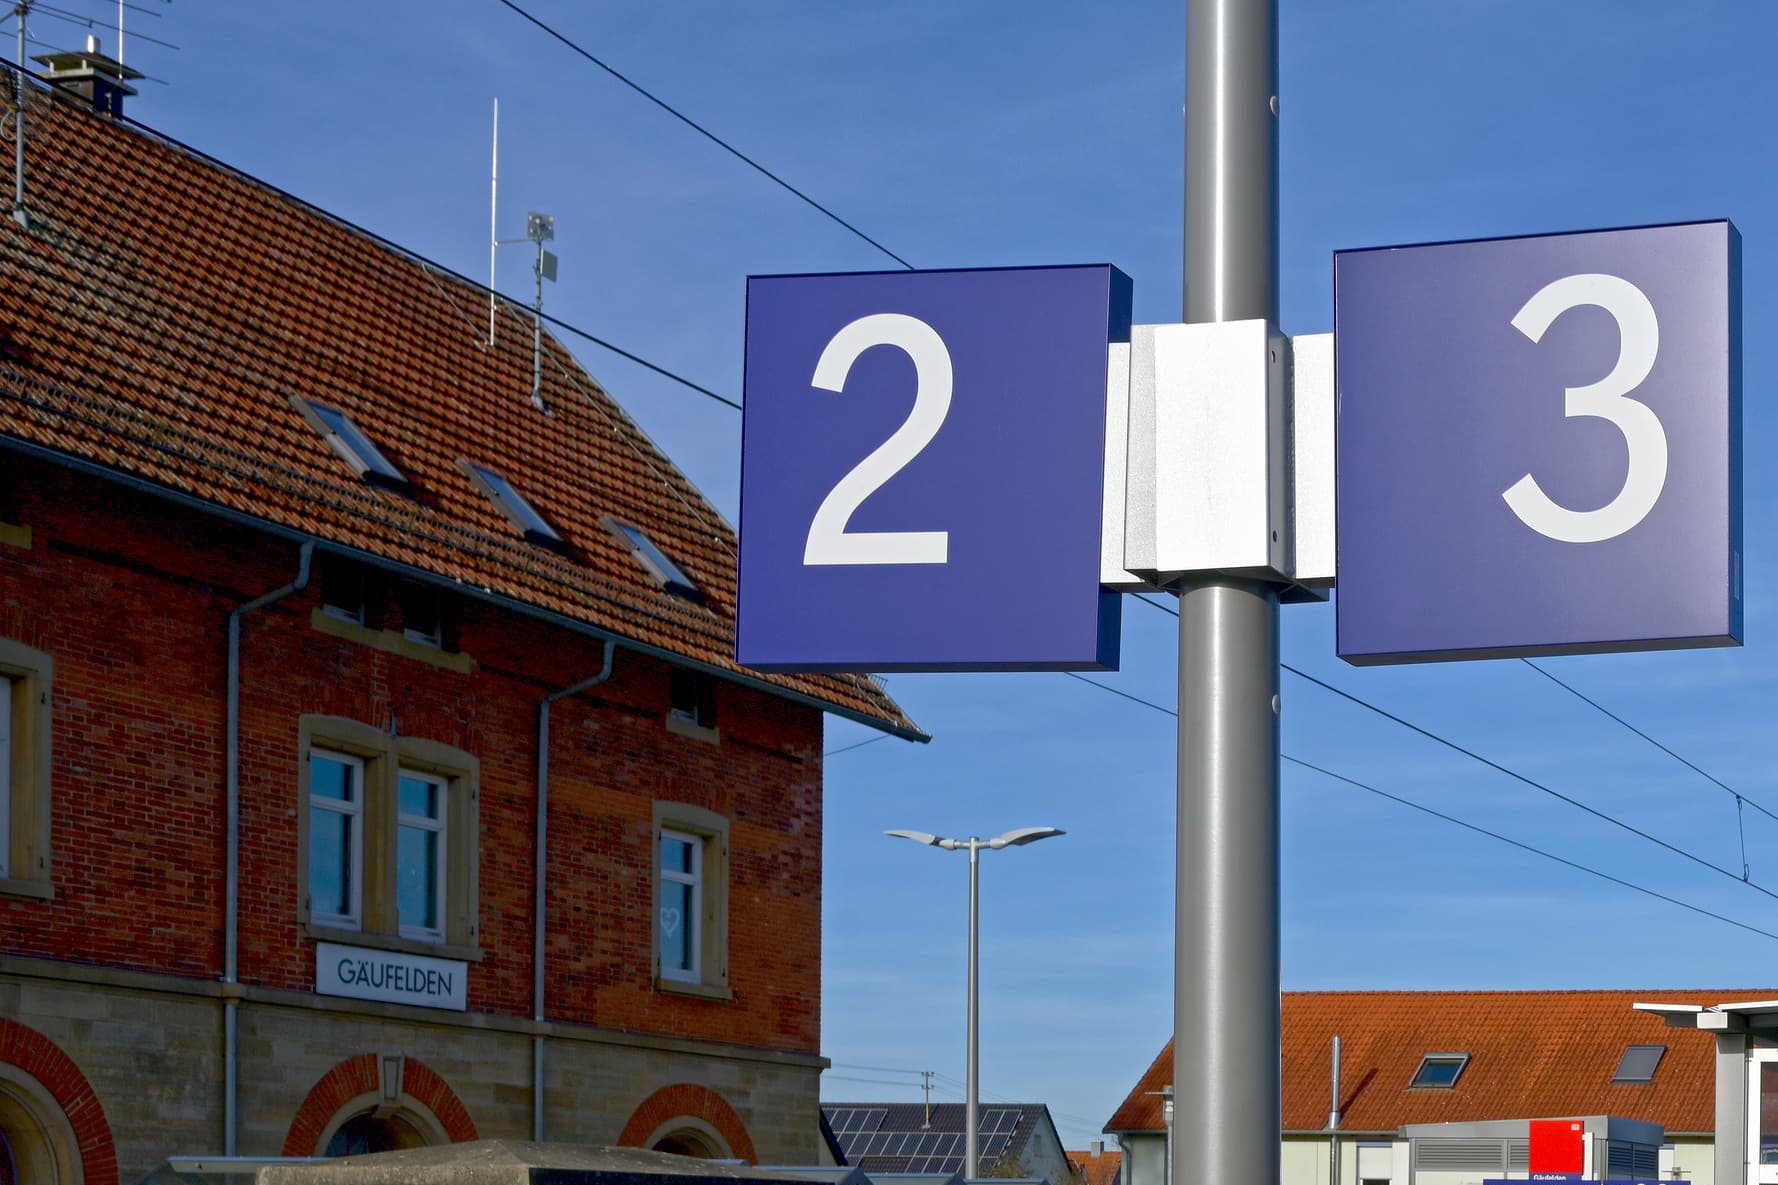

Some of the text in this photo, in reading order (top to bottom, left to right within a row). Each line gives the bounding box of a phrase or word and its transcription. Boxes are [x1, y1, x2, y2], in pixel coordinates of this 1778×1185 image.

[802, 312, 954, 566] 2
[1501, 274, 1668, 543] 3
[338, 958, 453, 996] GÄUFELDEN
